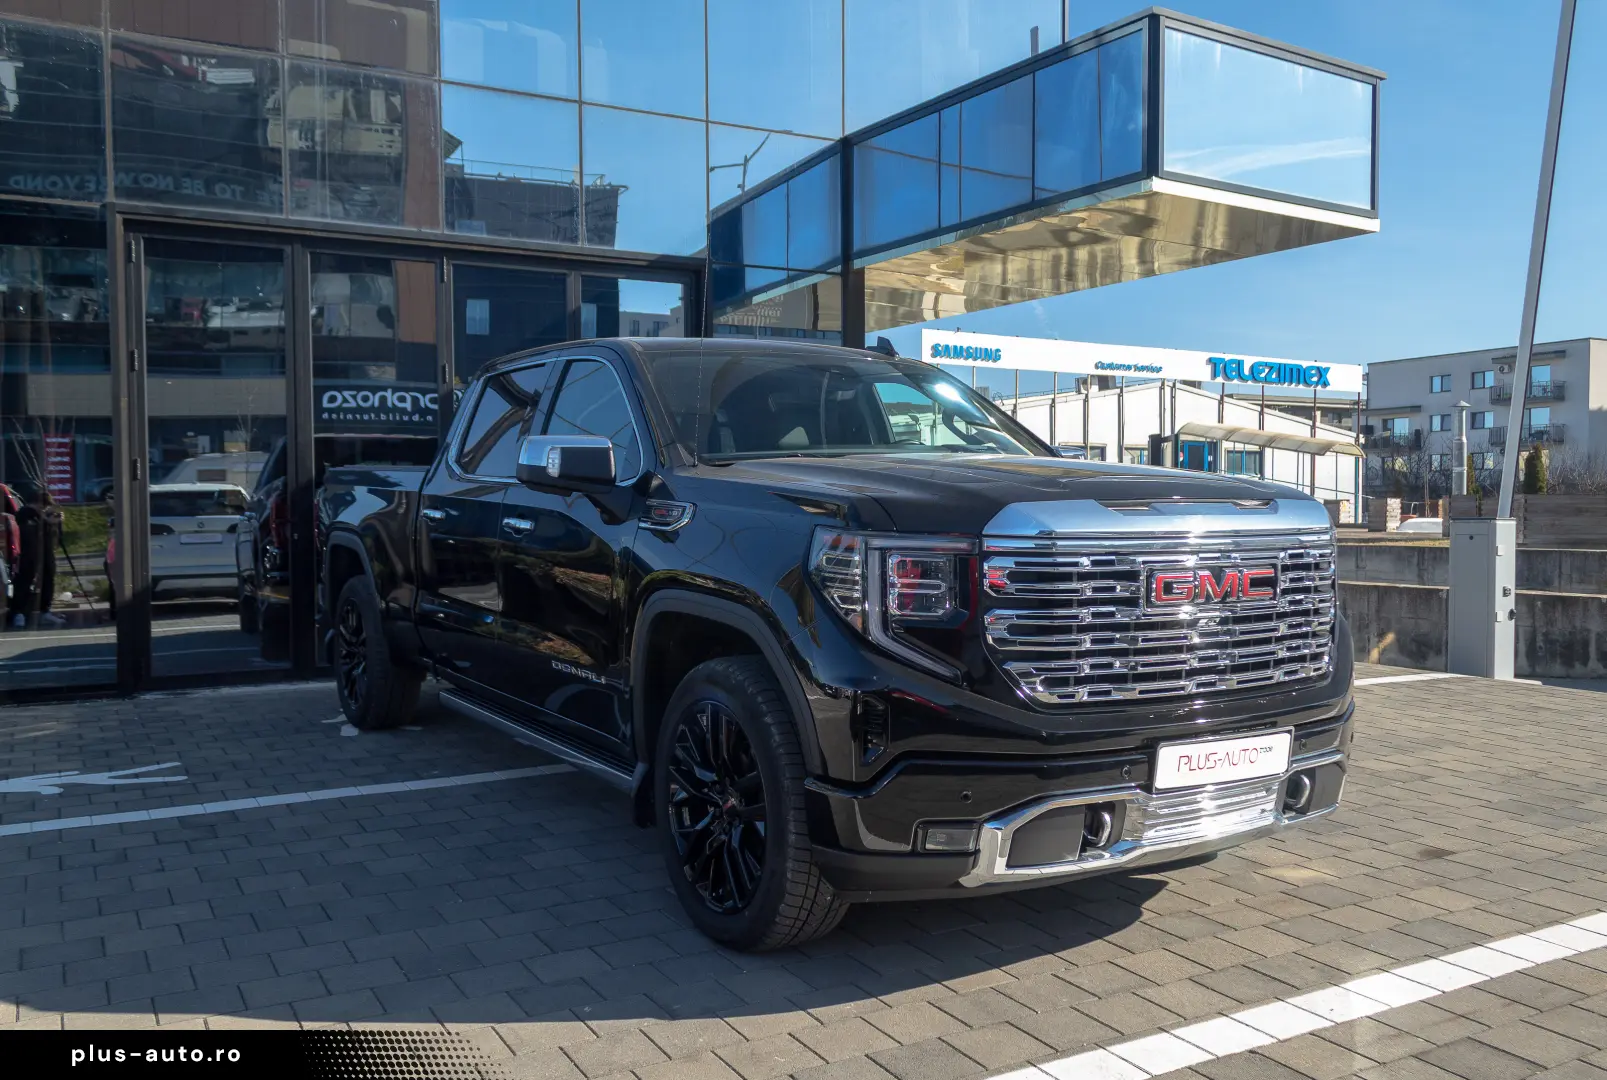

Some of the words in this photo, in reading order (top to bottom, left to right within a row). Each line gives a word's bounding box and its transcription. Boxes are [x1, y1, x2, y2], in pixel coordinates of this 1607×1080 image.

[931, 343, 1001, 362] SAMSUNG
[1206, 357, 1331, 388] TELEZIMEX
[1152, 568, 1274, 603] GMC
[1178, 748, 1259, 772] PLUS-AUTO
